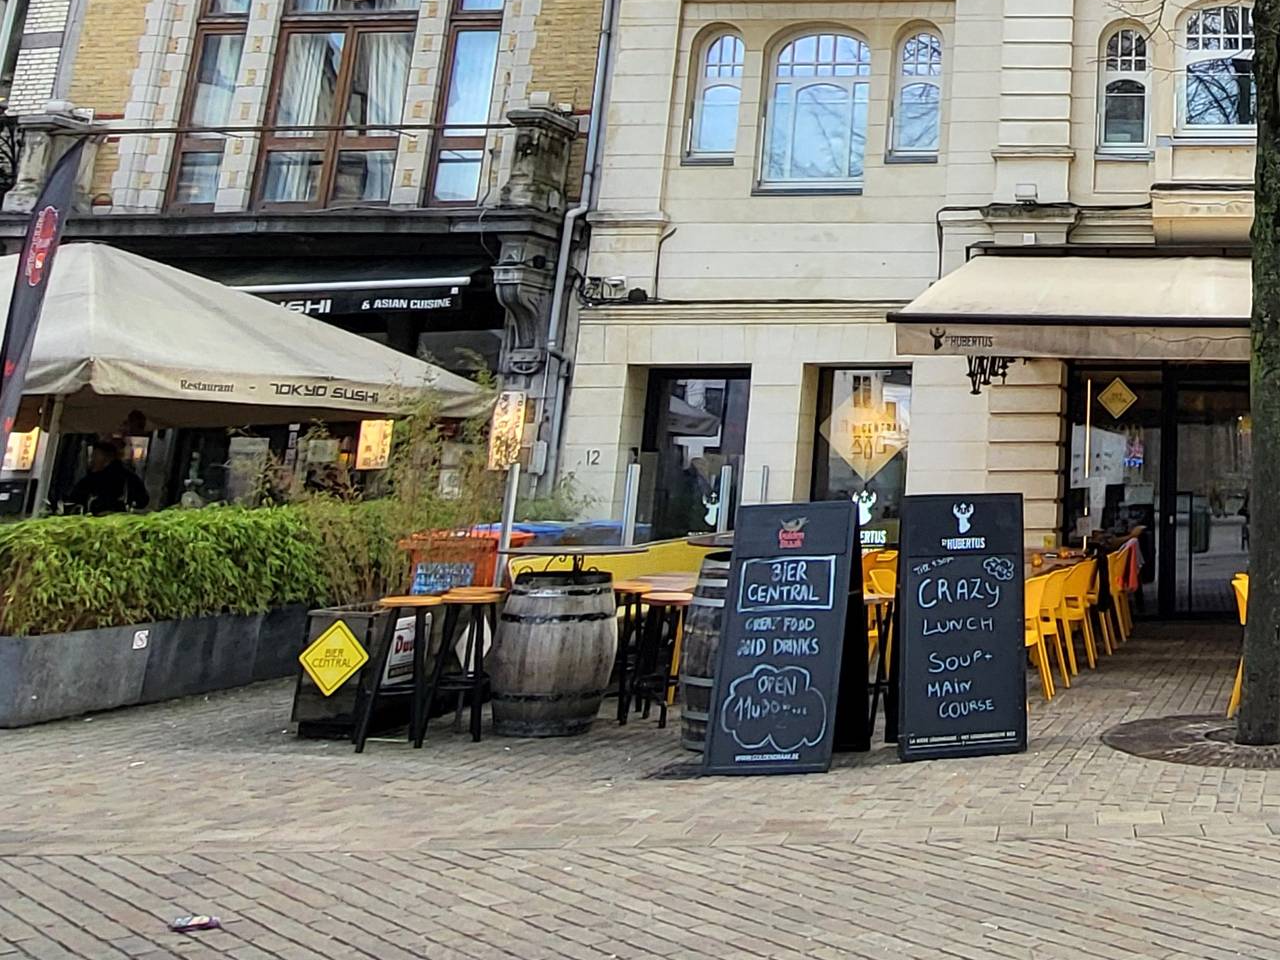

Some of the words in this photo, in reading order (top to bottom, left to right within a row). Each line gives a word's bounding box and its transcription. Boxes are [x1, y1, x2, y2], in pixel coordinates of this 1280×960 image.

[279, 299, 332, 314] SHI
[361, 300, 371, 310] &
[373, 299, 408, 309] ASIAN
[410, 297, 452, 309] CUISINE
[180, 380, 234, 392] Restaurant
[270, 384, 327, 397] TOKYO
[587, 450, 601, 466] 12
[860, 530, 887, 544] ERTUS
[947, 537, 986, 550] HUBERTUS
[771, 561, 808, 583] BIER
[747, 584, 820, 604] CENTRAL
[919, 578, 1000, 609] CRAZY
[783, 617, 815, 632] FOOD
[923, 617, 993, 636] LUNCH
[324, 648, 344, 657] BIER
[773, 638, 819, 655] DRINKS
[311, 658, 352, 668] CENTRAL
[758, 675, 798, 696] OPEN
[939, 699, 994, 718] COURSE
